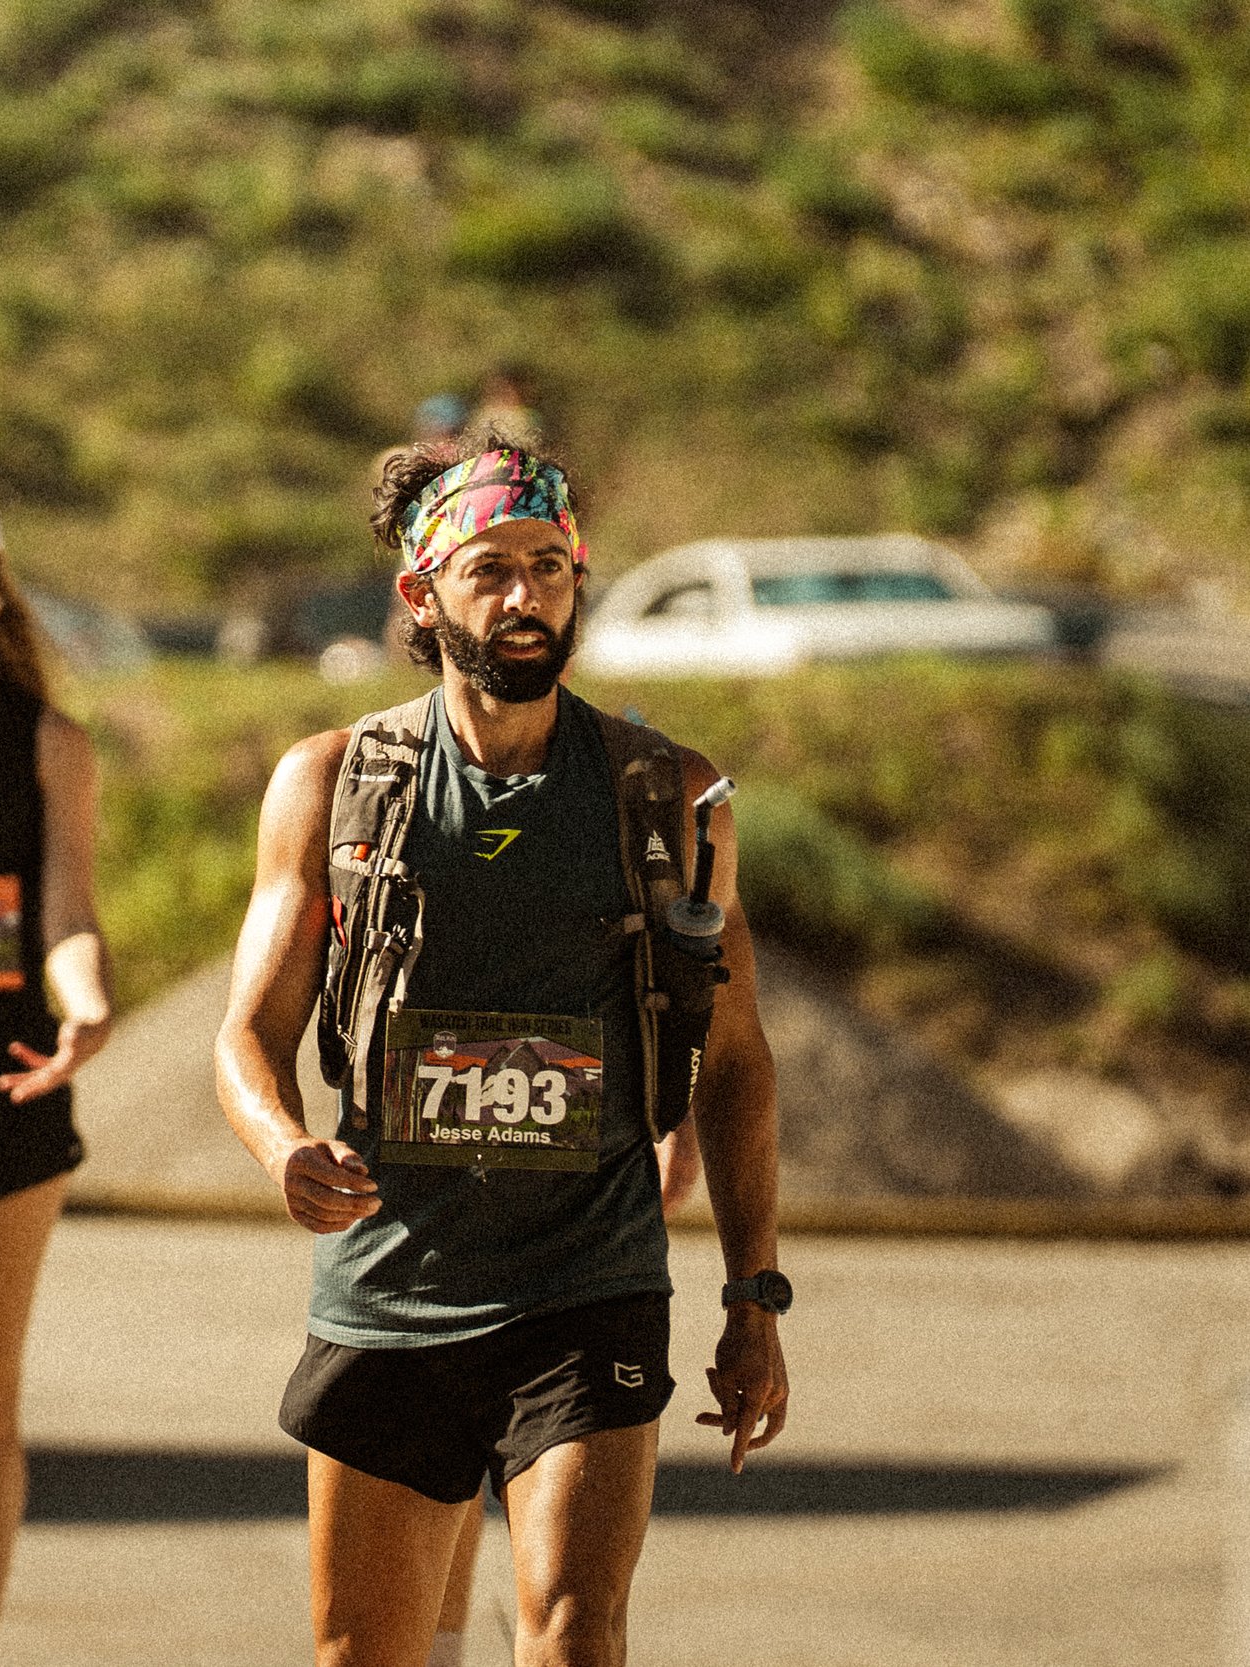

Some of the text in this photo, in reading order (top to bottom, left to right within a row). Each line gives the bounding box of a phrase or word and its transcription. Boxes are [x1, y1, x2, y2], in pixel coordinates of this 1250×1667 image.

[418, 1066, 567, 1125] 7193
[430, 1124, 551, 1144] Jesse Adams
